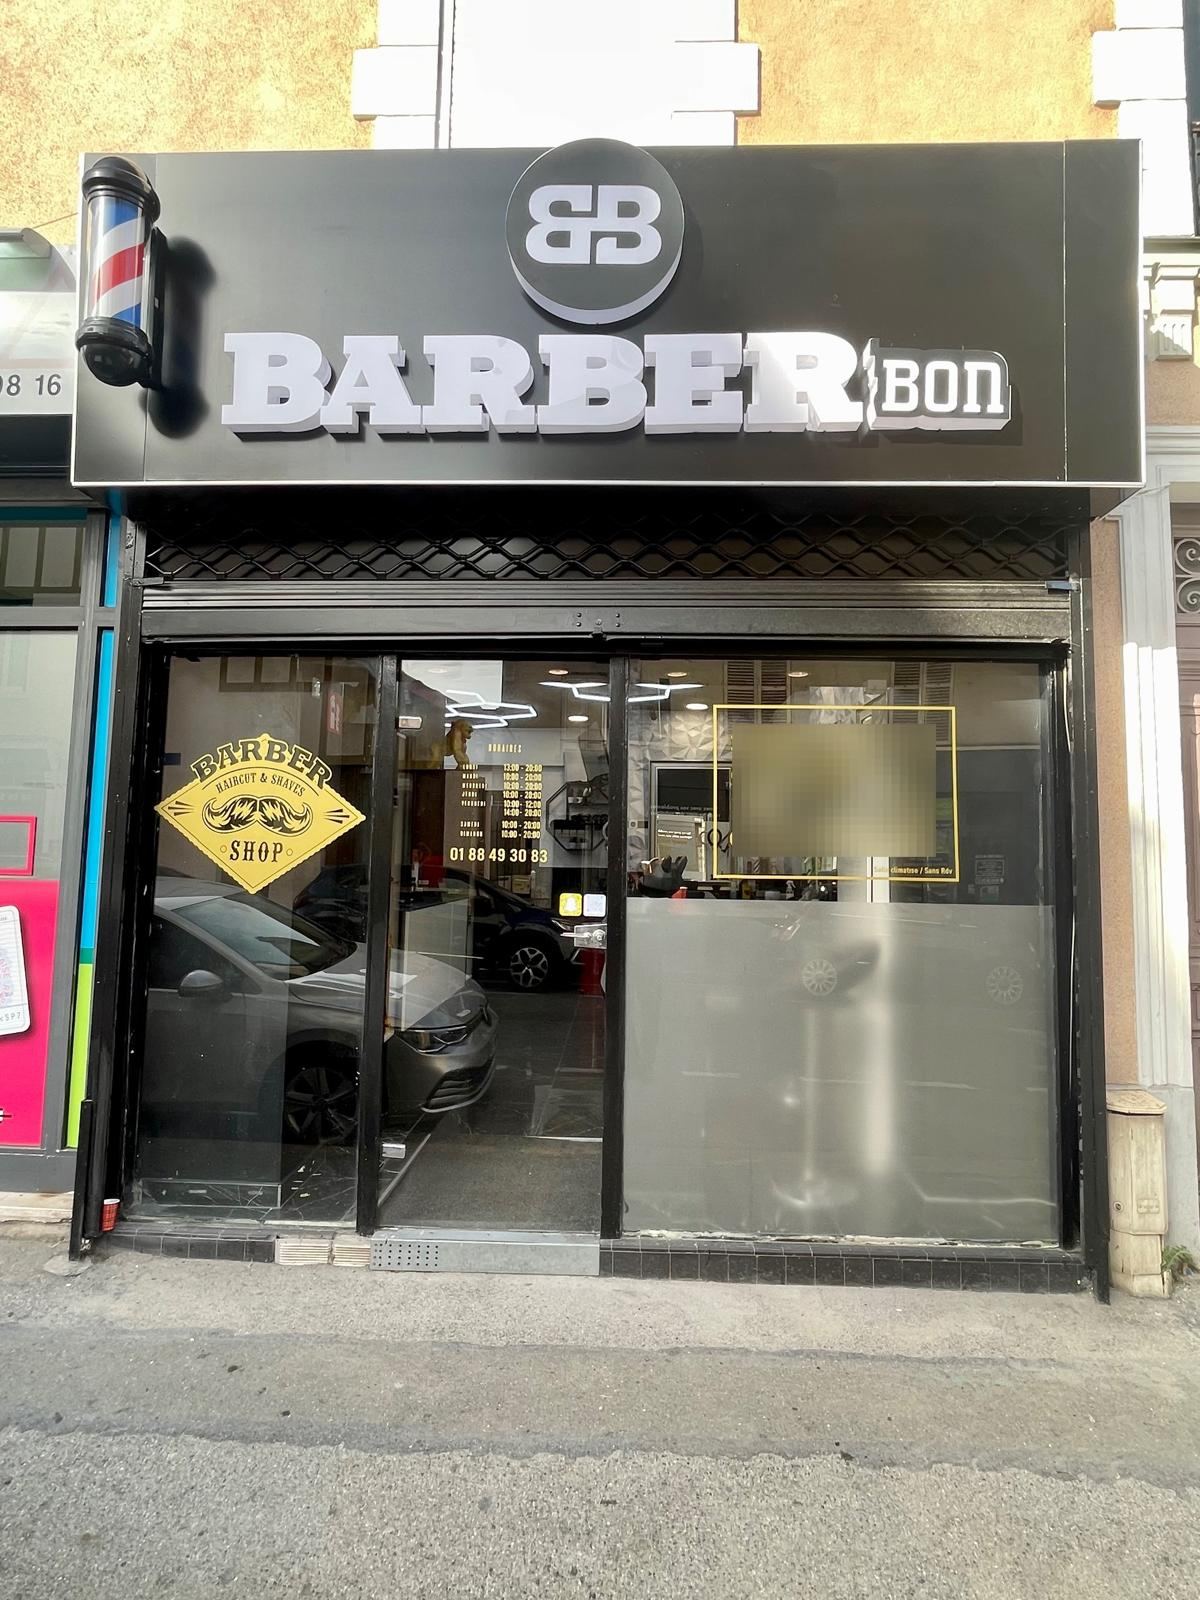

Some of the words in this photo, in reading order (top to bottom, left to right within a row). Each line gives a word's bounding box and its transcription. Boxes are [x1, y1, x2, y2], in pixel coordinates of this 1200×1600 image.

[0, 374, 21, 396] 8
[35, 374, 62, 396] 16
[221, 331, 864, 434] BARBER
[881, 359, 1005, 414] BON
[191, 739, 333, 789] BARBER
[216, 773, 256, 793] HAIRCUT
[260, 773, 267, 783] &
[271, 775, 306, 797] SHAVES
[230, 840, 283, 862] SHOP
[450, 847, 464, 861] 01
[468, 848, 485, 862] 88
[489, 848, 506, 862] 49
[510, 848, 527, 863] 30
[531, 849, 548, 863] 83
